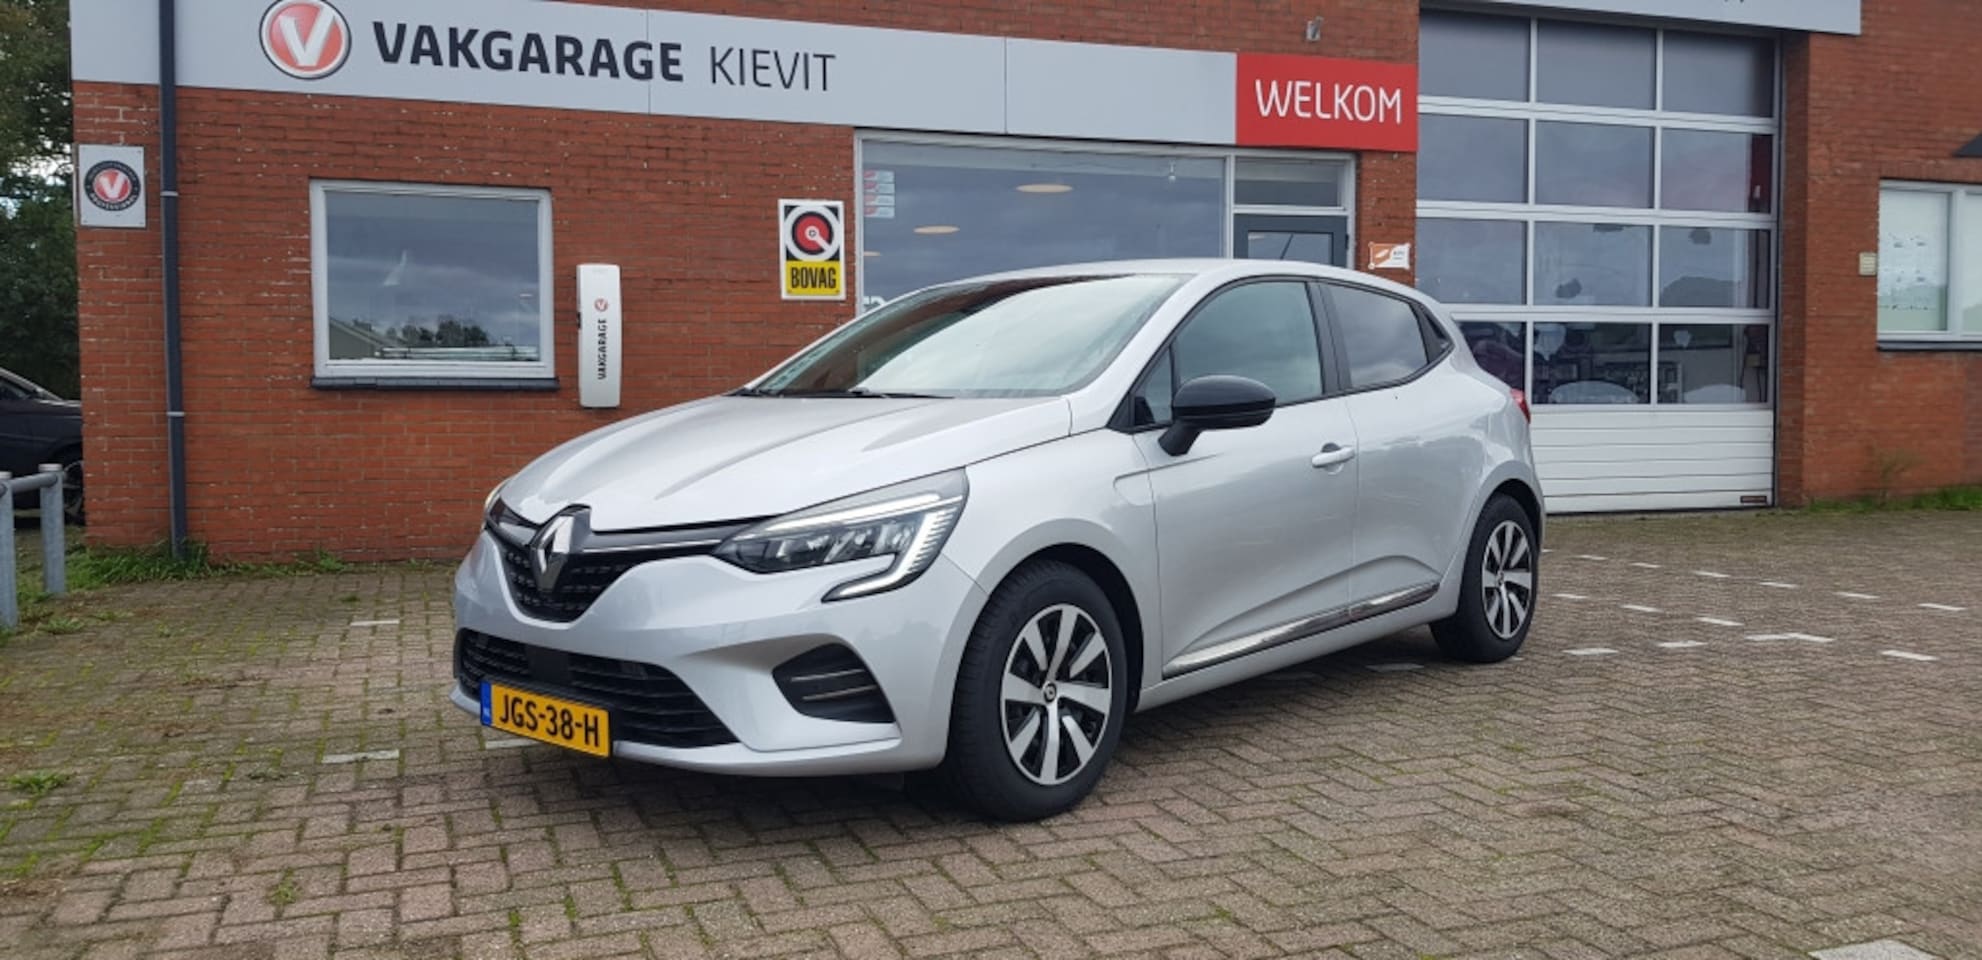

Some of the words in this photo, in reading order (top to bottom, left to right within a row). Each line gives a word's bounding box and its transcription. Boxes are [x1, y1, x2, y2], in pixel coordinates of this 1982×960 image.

[372, 20, 684, 83] VAKGARAGE
[709, 45, 837, 92] KIEVIT
[1255, 79, 1402, 125] WELKOM
[790, 266, 837, 289] BOVAG
[597, 318, 608, 381] VAKGARAGE
[499, 693, 600, 748] JGS-38-H
